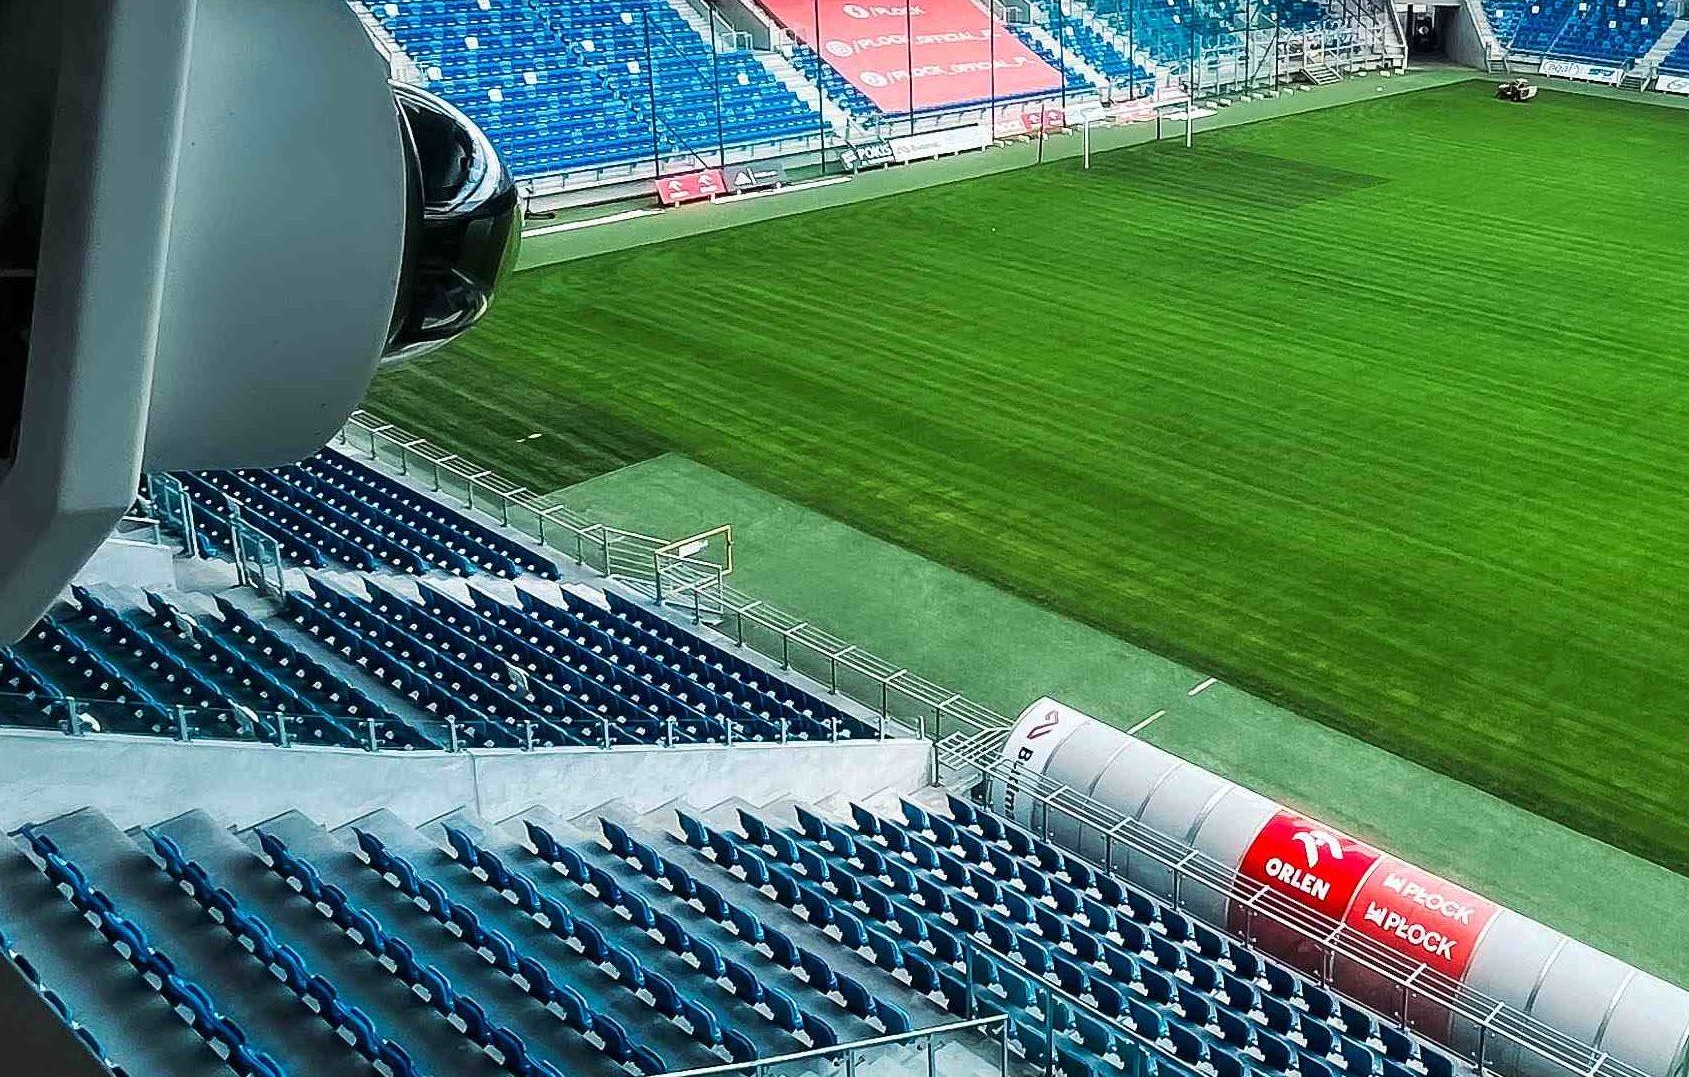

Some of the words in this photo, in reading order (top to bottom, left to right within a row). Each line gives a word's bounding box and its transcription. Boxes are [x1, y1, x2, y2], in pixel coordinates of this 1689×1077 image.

[1265, 857, 1331, 901] ORLEN
[1401, 883, 1477, 925] PŁOCK
[1383, 909, 1458, 961] PŁOCK
